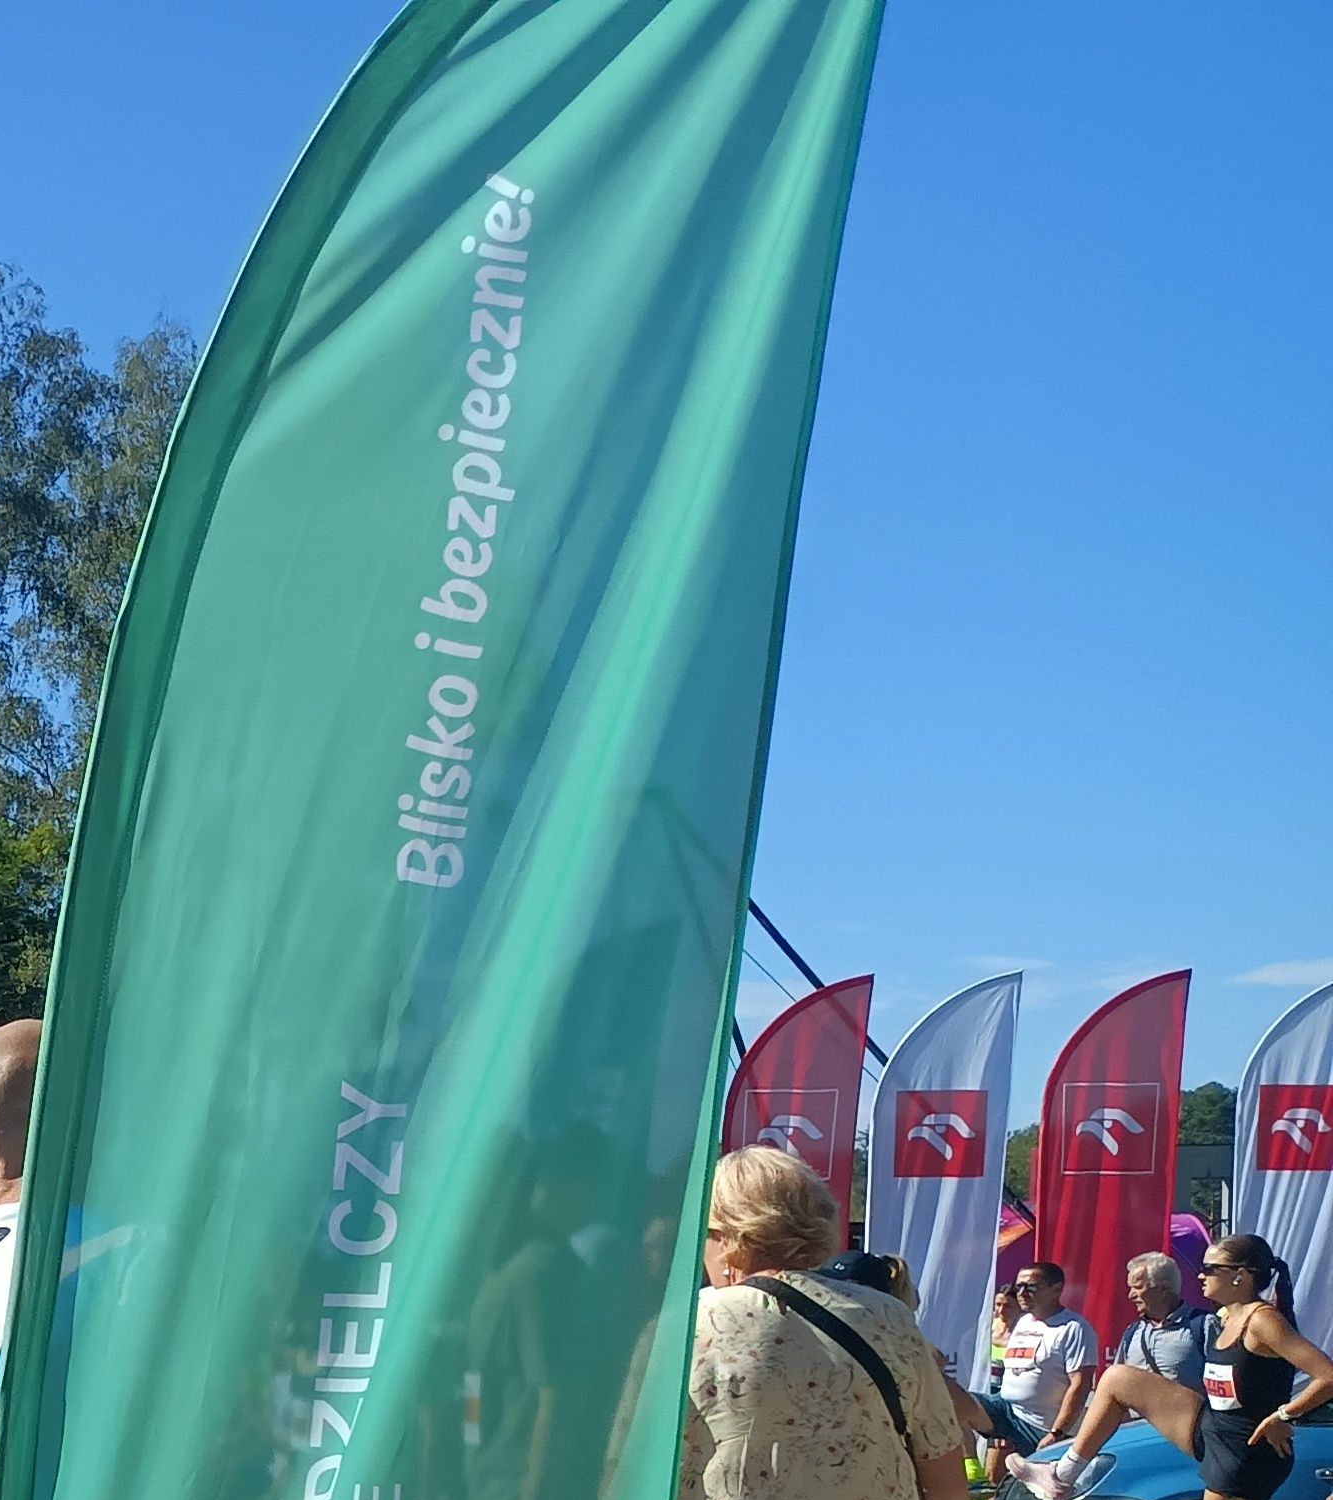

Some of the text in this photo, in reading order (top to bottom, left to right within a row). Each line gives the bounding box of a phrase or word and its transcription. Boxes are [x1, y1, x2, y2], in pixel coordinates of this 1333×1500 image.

[396, 172, 536, 889] Blisko i bezpiecznie!
